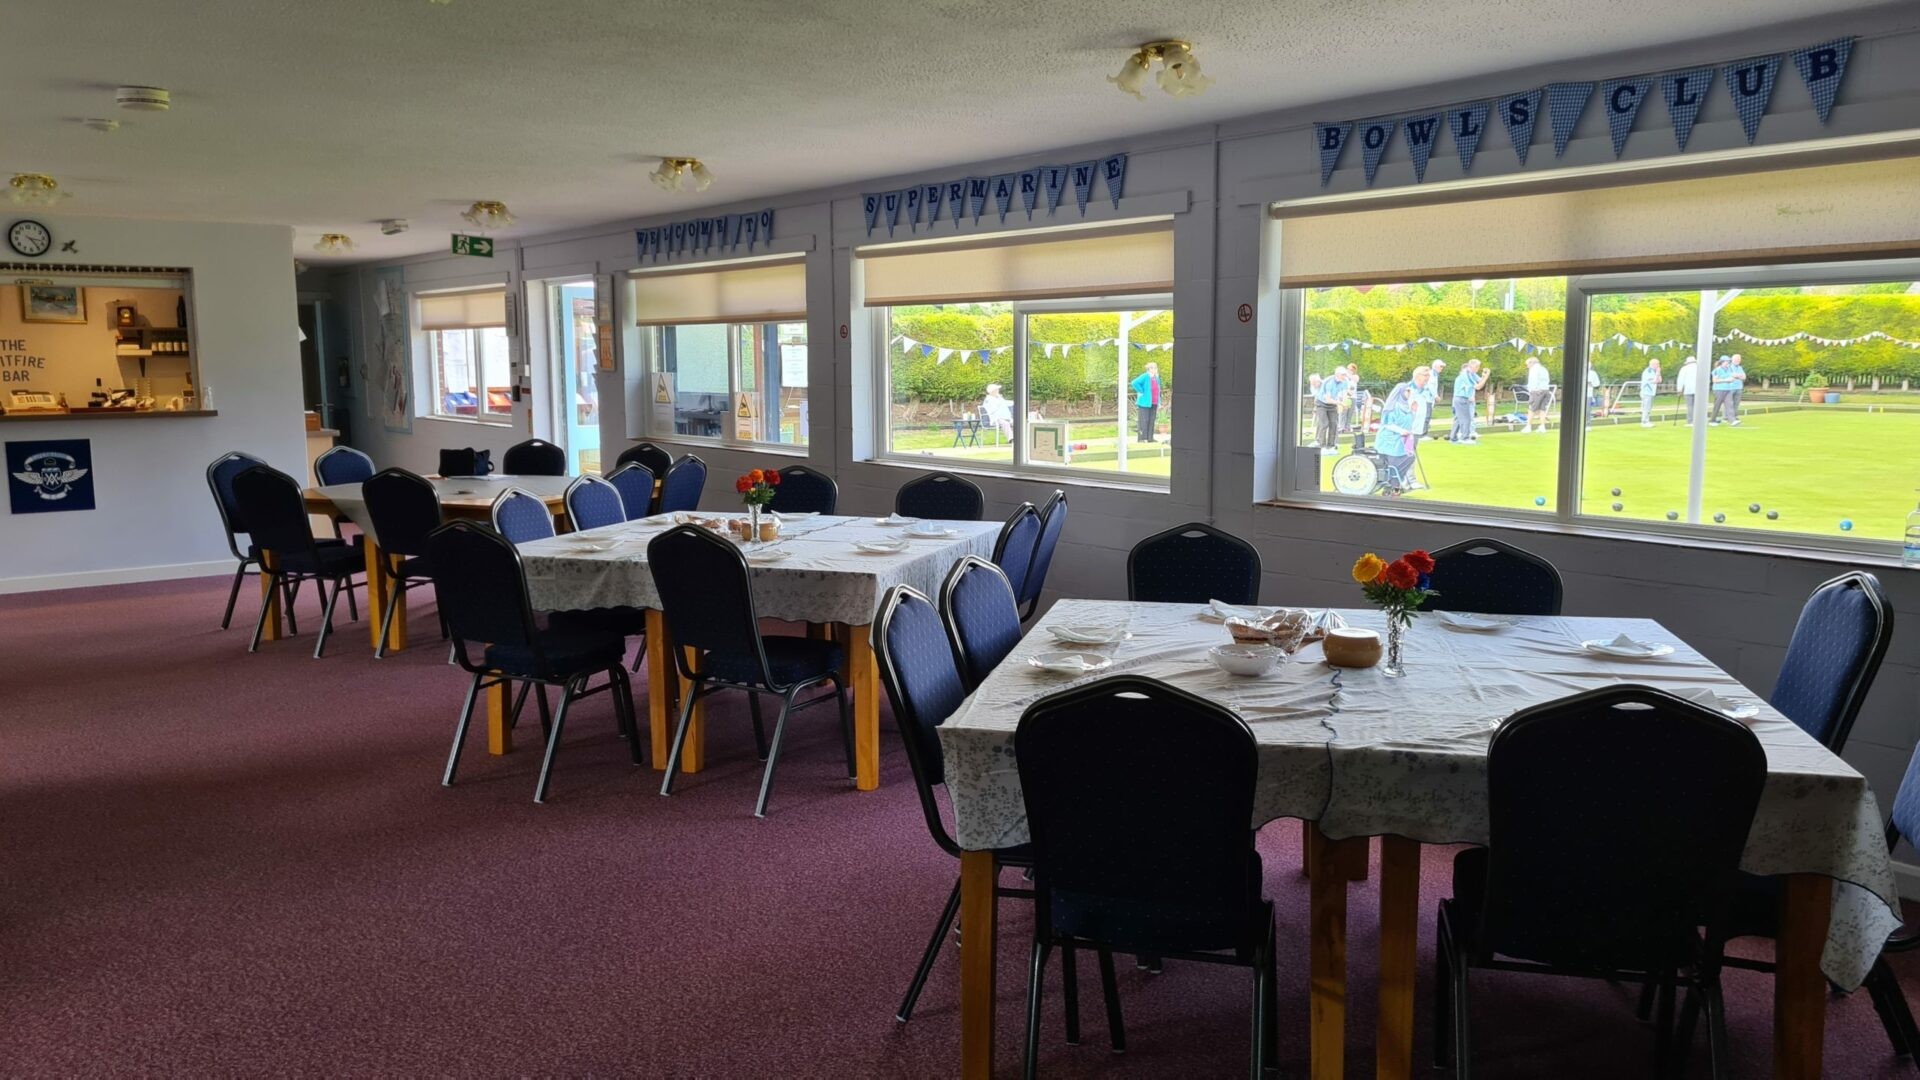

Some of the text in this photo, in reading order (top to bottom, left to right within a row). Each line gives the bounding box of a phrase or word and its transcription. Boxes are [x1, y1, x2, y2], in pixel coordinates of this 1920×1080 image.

[1322, 48, 1838, 150] BOWLS CLUB
[865, 157, 1121, 214] SUPERMARINE
[636, 212, 769, 245] WELCOME TO
[0, 339, 26, 351] THE
[2, 370, 30, 382] BAR
